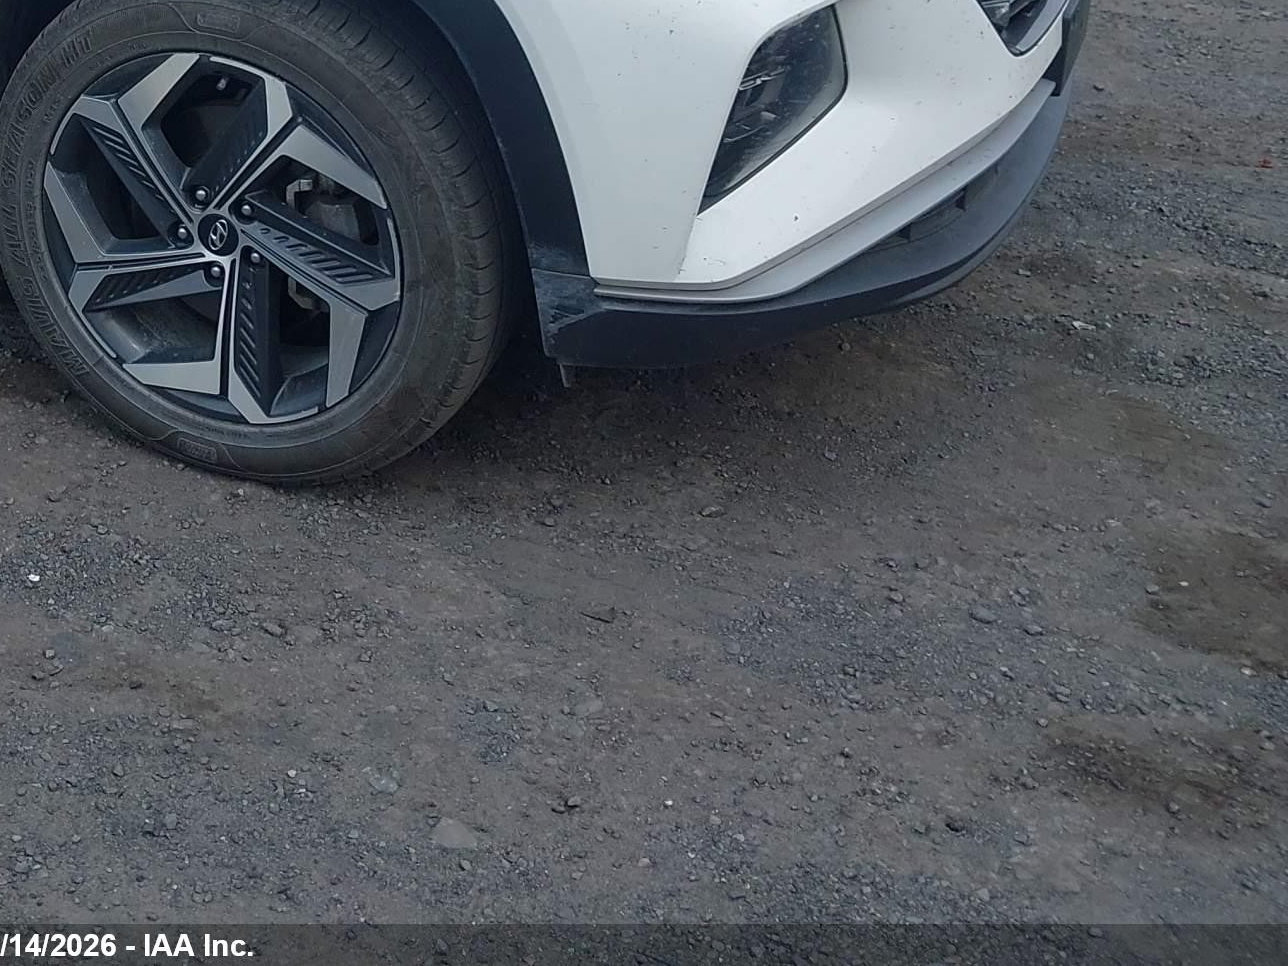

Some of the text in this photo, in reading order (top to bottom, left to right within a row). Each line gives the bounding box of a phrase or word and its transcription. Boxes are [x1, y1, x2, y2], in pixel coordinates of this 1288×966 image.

[0, 57, 59, 188] SEASON
[0, 198, 30, 267] ALL
[18, 275, 91, 377] MAVIS
